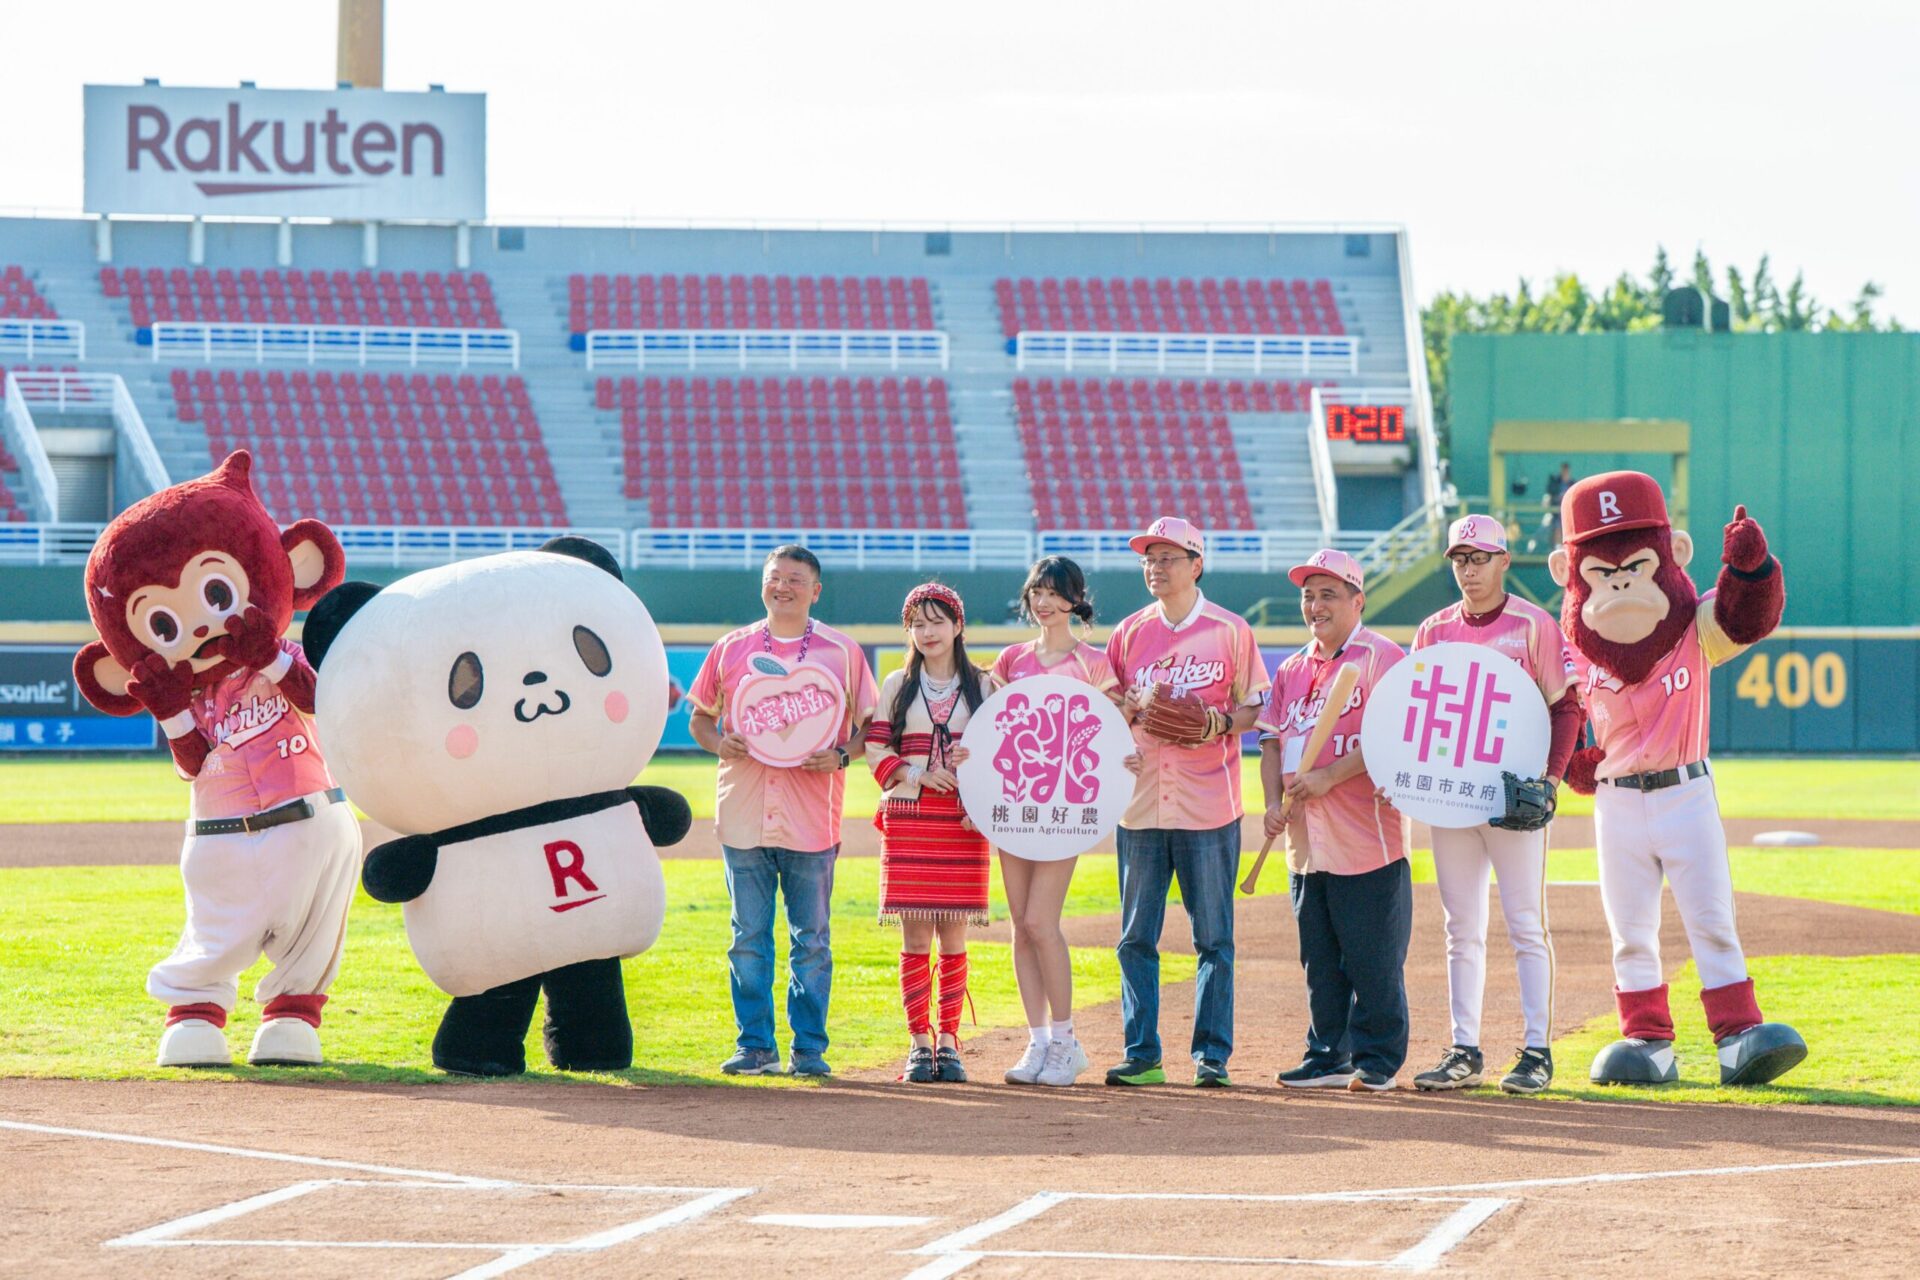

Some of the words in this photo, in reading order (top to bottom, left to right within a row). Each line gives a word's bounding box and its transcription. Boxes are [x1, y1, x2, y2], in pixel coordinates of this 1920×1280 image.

[127, 102, 444, 176] Rakuten
[1599, 491, 1622, 517] R
[1461, 521, 1476, 539] R
[1661, 666, 1690, 697] 10
[1736, 652, 1847, 708] 400
[214, 694, 289, 745] Monkeys
[277, 734, 308, 760] 10
[1395, 771, 1497, 801] 桃園市政府
[992, 805, 1099, 826] 桃園好農
[1393, 791, 1426, 803] TAOYUAN
[1427, 797, 1444, 805] CITY
[1445, 800, 1495, 812] GOVERNMENT
[992, 824, 1035, 834] Taoyuan
[1038, 825, 1099, 836] Agriculture
[543, 839, 600, 898] R
